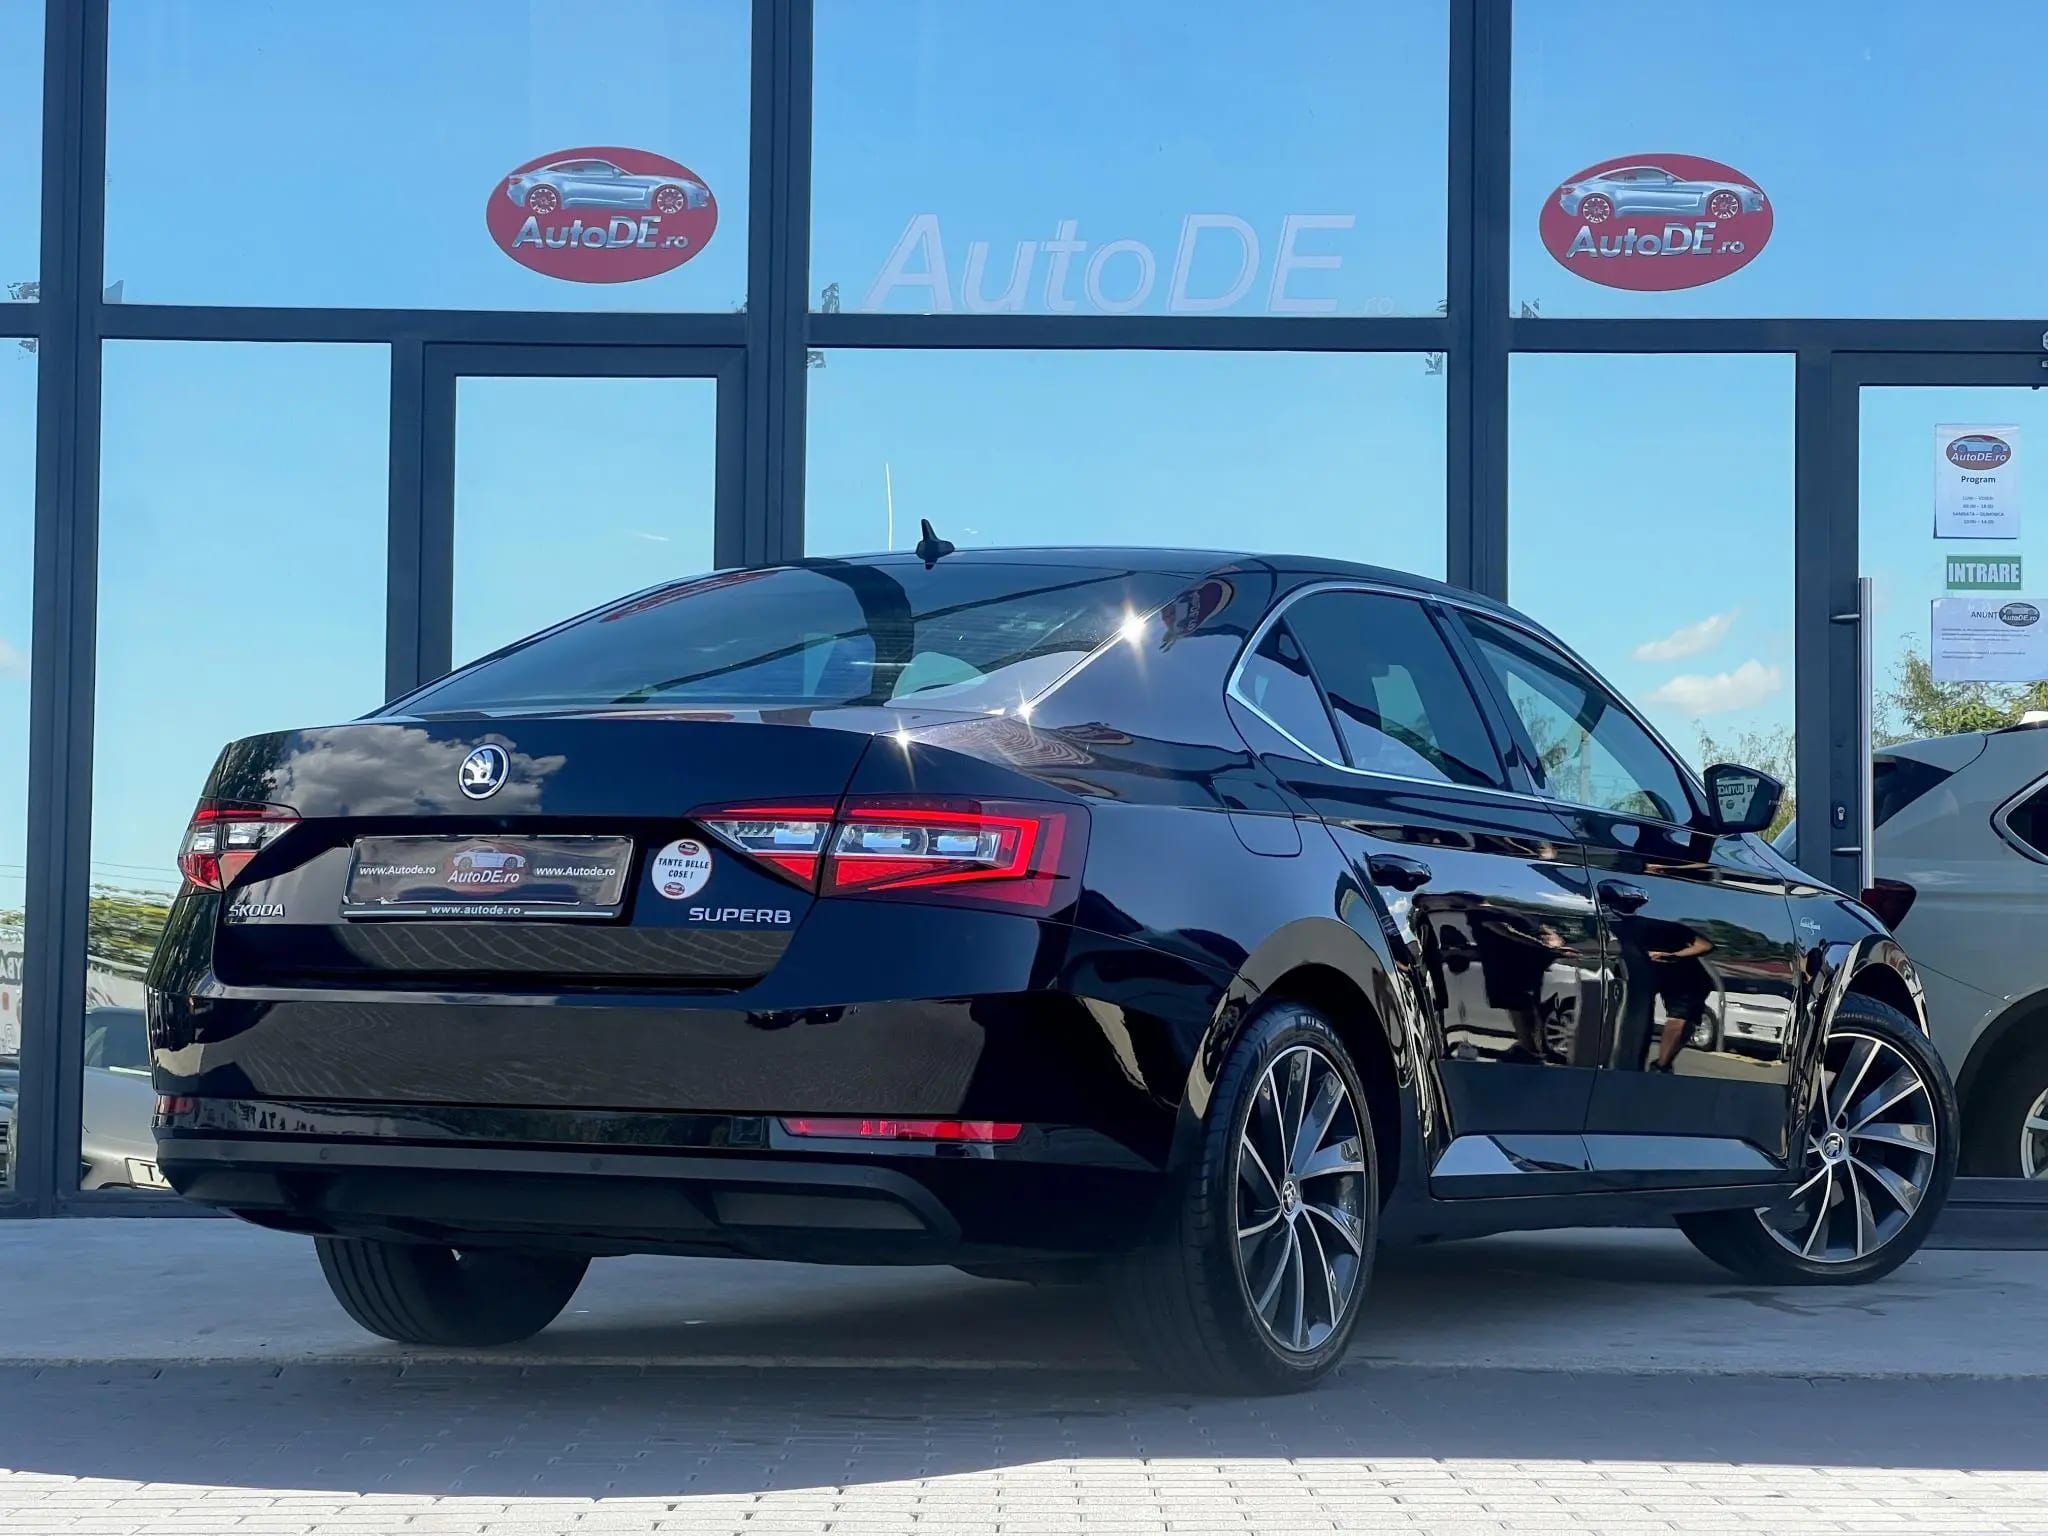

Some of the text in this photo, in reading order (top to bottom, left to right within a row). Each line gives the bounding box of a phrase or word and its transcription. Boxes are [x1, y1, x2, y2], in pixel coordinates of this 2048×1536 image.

[1951, 452, 2007, 462] AutoDE.ro
[1961, 475, 1996, 485] Program
[1948, 563, 2020, 582] INTRARE
[2002, 614, 2038, 622] AutoDE.ro
[658, 858, 710, 869] TANTE BELLE
[359, 865, 436, 875] www.Autode.ro
[535, 866, 616, 877] www.Autode.ro
[668, 870, 689, 878] COSE
[447, 870, 520, 883] AutoDE.ro
[431, 905, 521, 915] www.autode.ro
[689, 907, 792, 924] SUPERB
